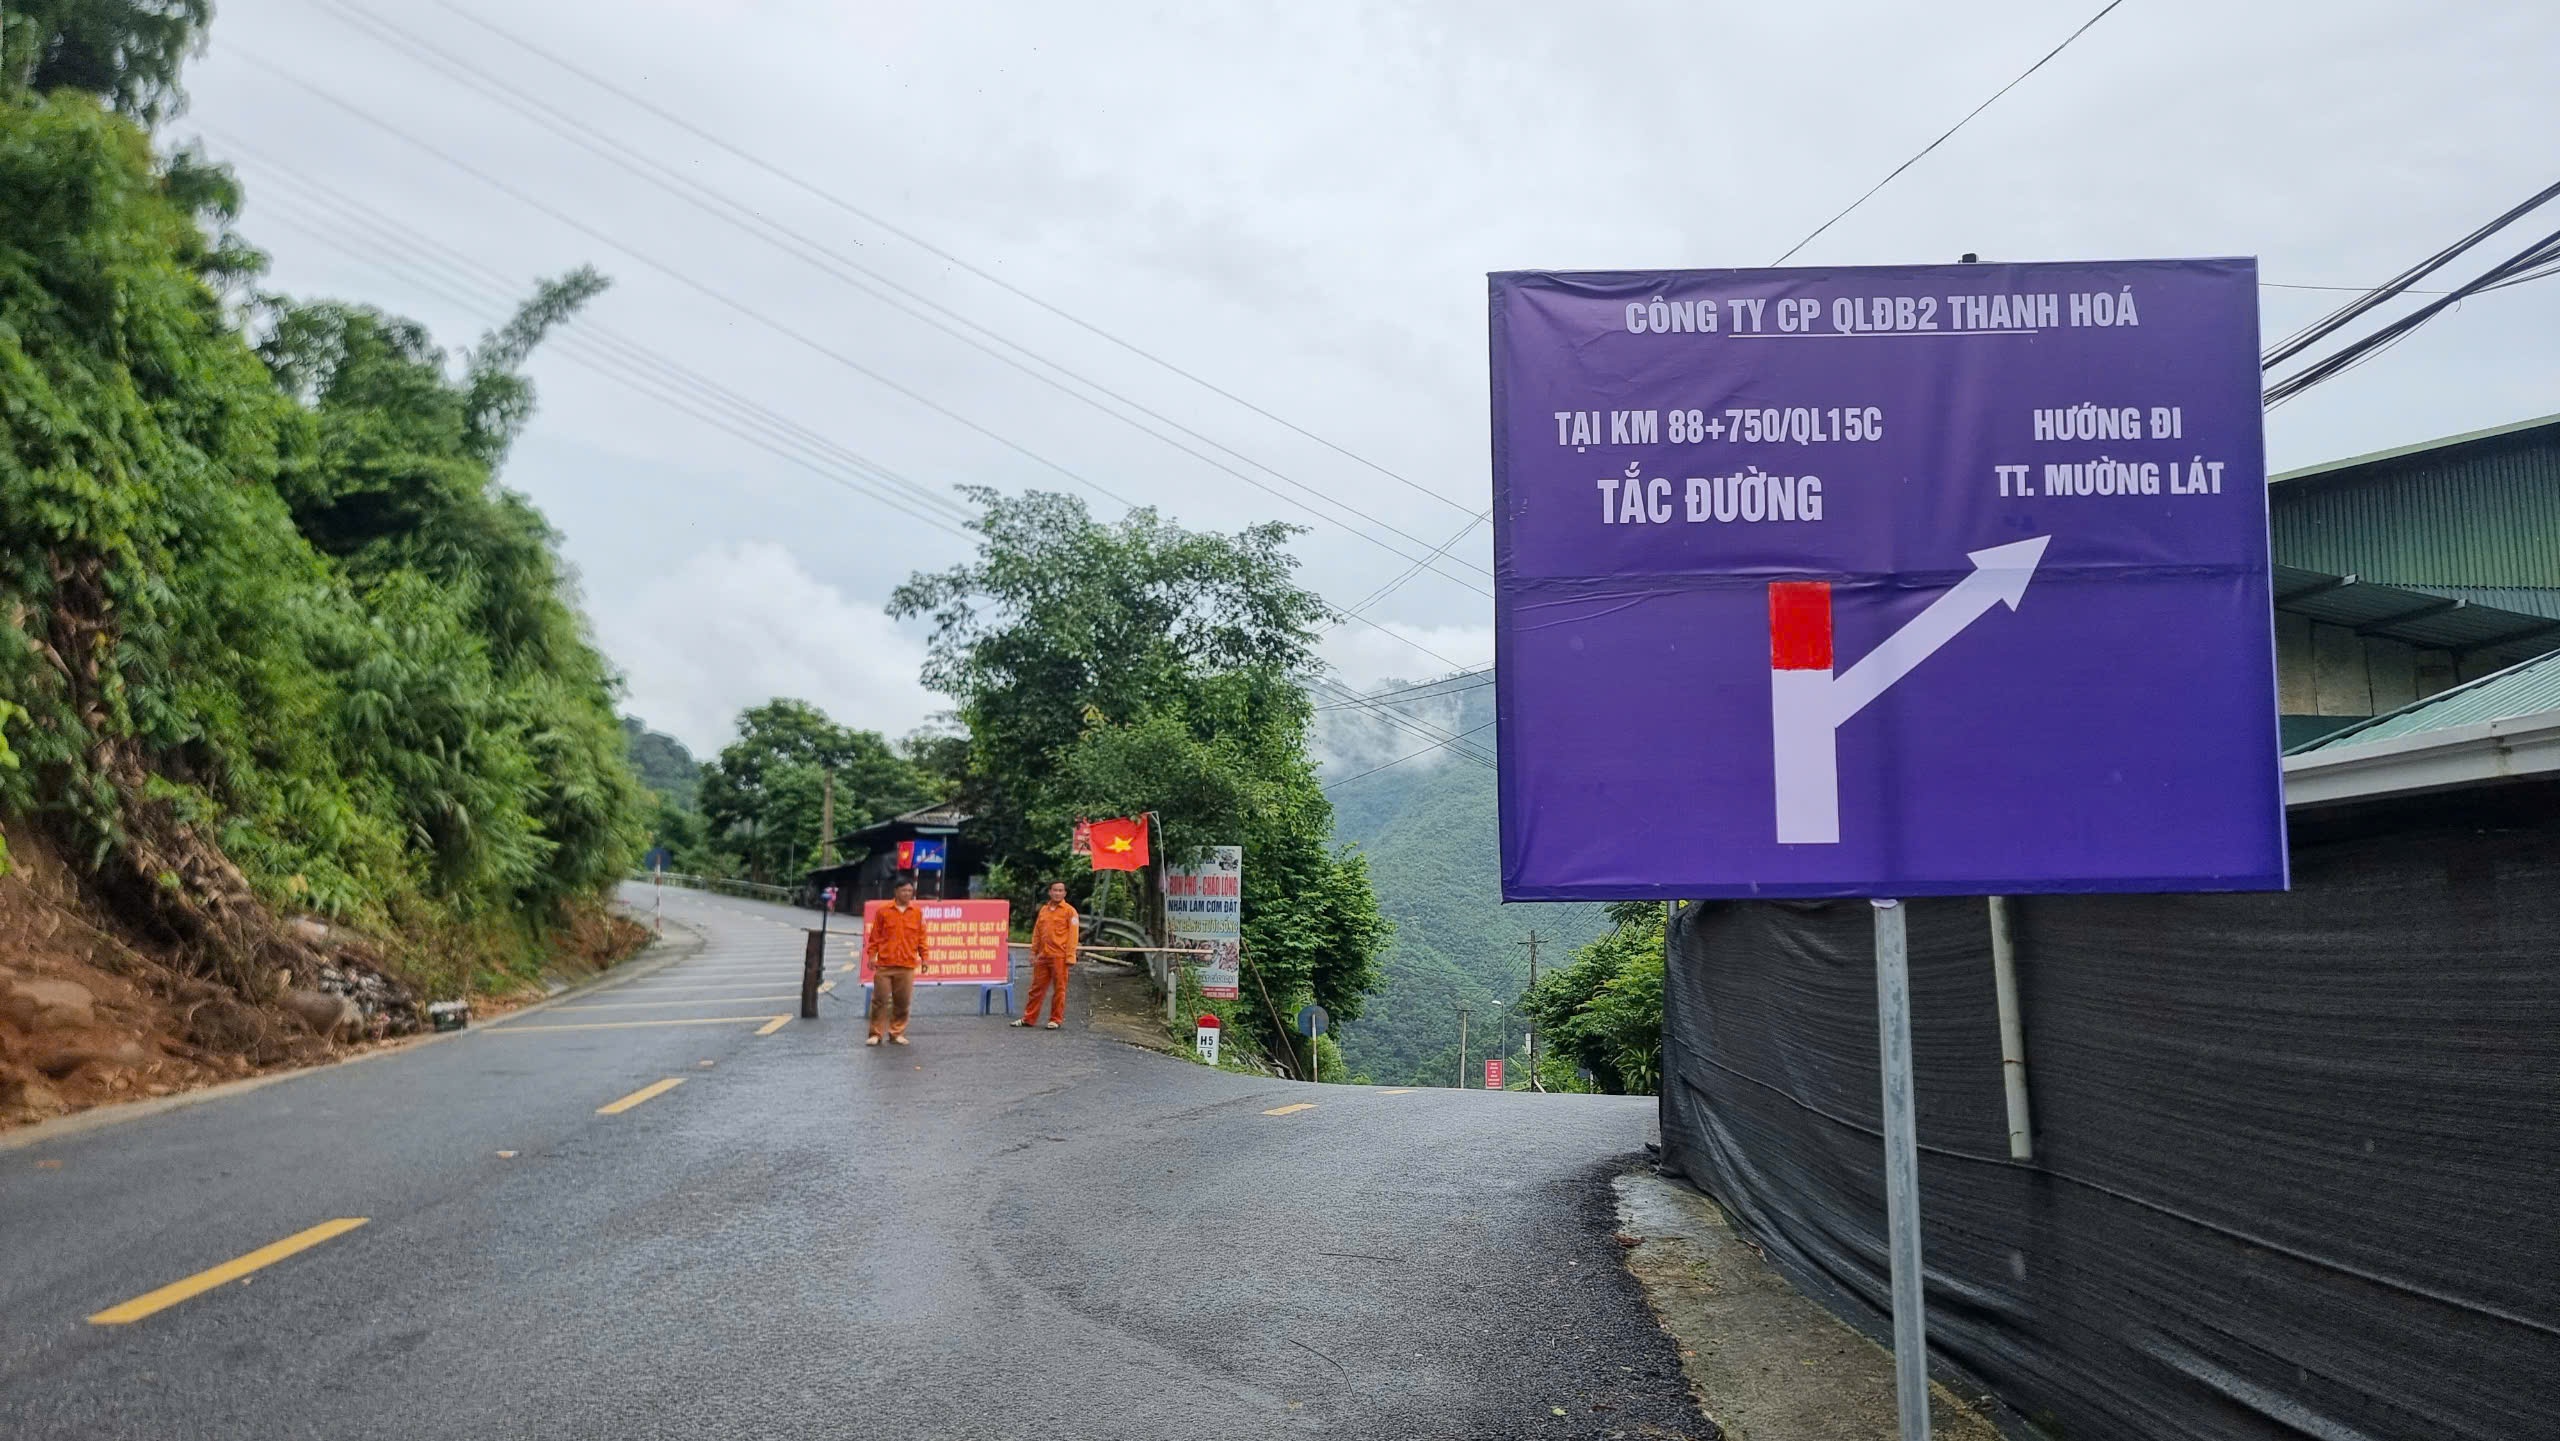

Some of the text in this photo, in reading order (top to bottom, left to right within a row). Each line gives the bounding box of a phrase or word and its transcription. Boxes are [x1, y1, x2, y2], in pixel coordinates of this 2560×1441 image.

[1625, 285, 2139, 334] CÔNG TY CP QLĐB2 THANH HOÁ
[1554, 406, 1883, 453] TẠI KM 88+750/QL15C
[2033, 401, 2182, 441] HƯỚNG ĐI
[1597, 461, 1823, 523] TẮC ĐƯỜNG
[1995, 455, 2225, 497] TT. MƯỜNG LÁT
[1168, 897, 1188, 915] NHẬN
[1190, 897, 1204, 912] LÀM
[1206, 900, 1222, 912] CƠM
